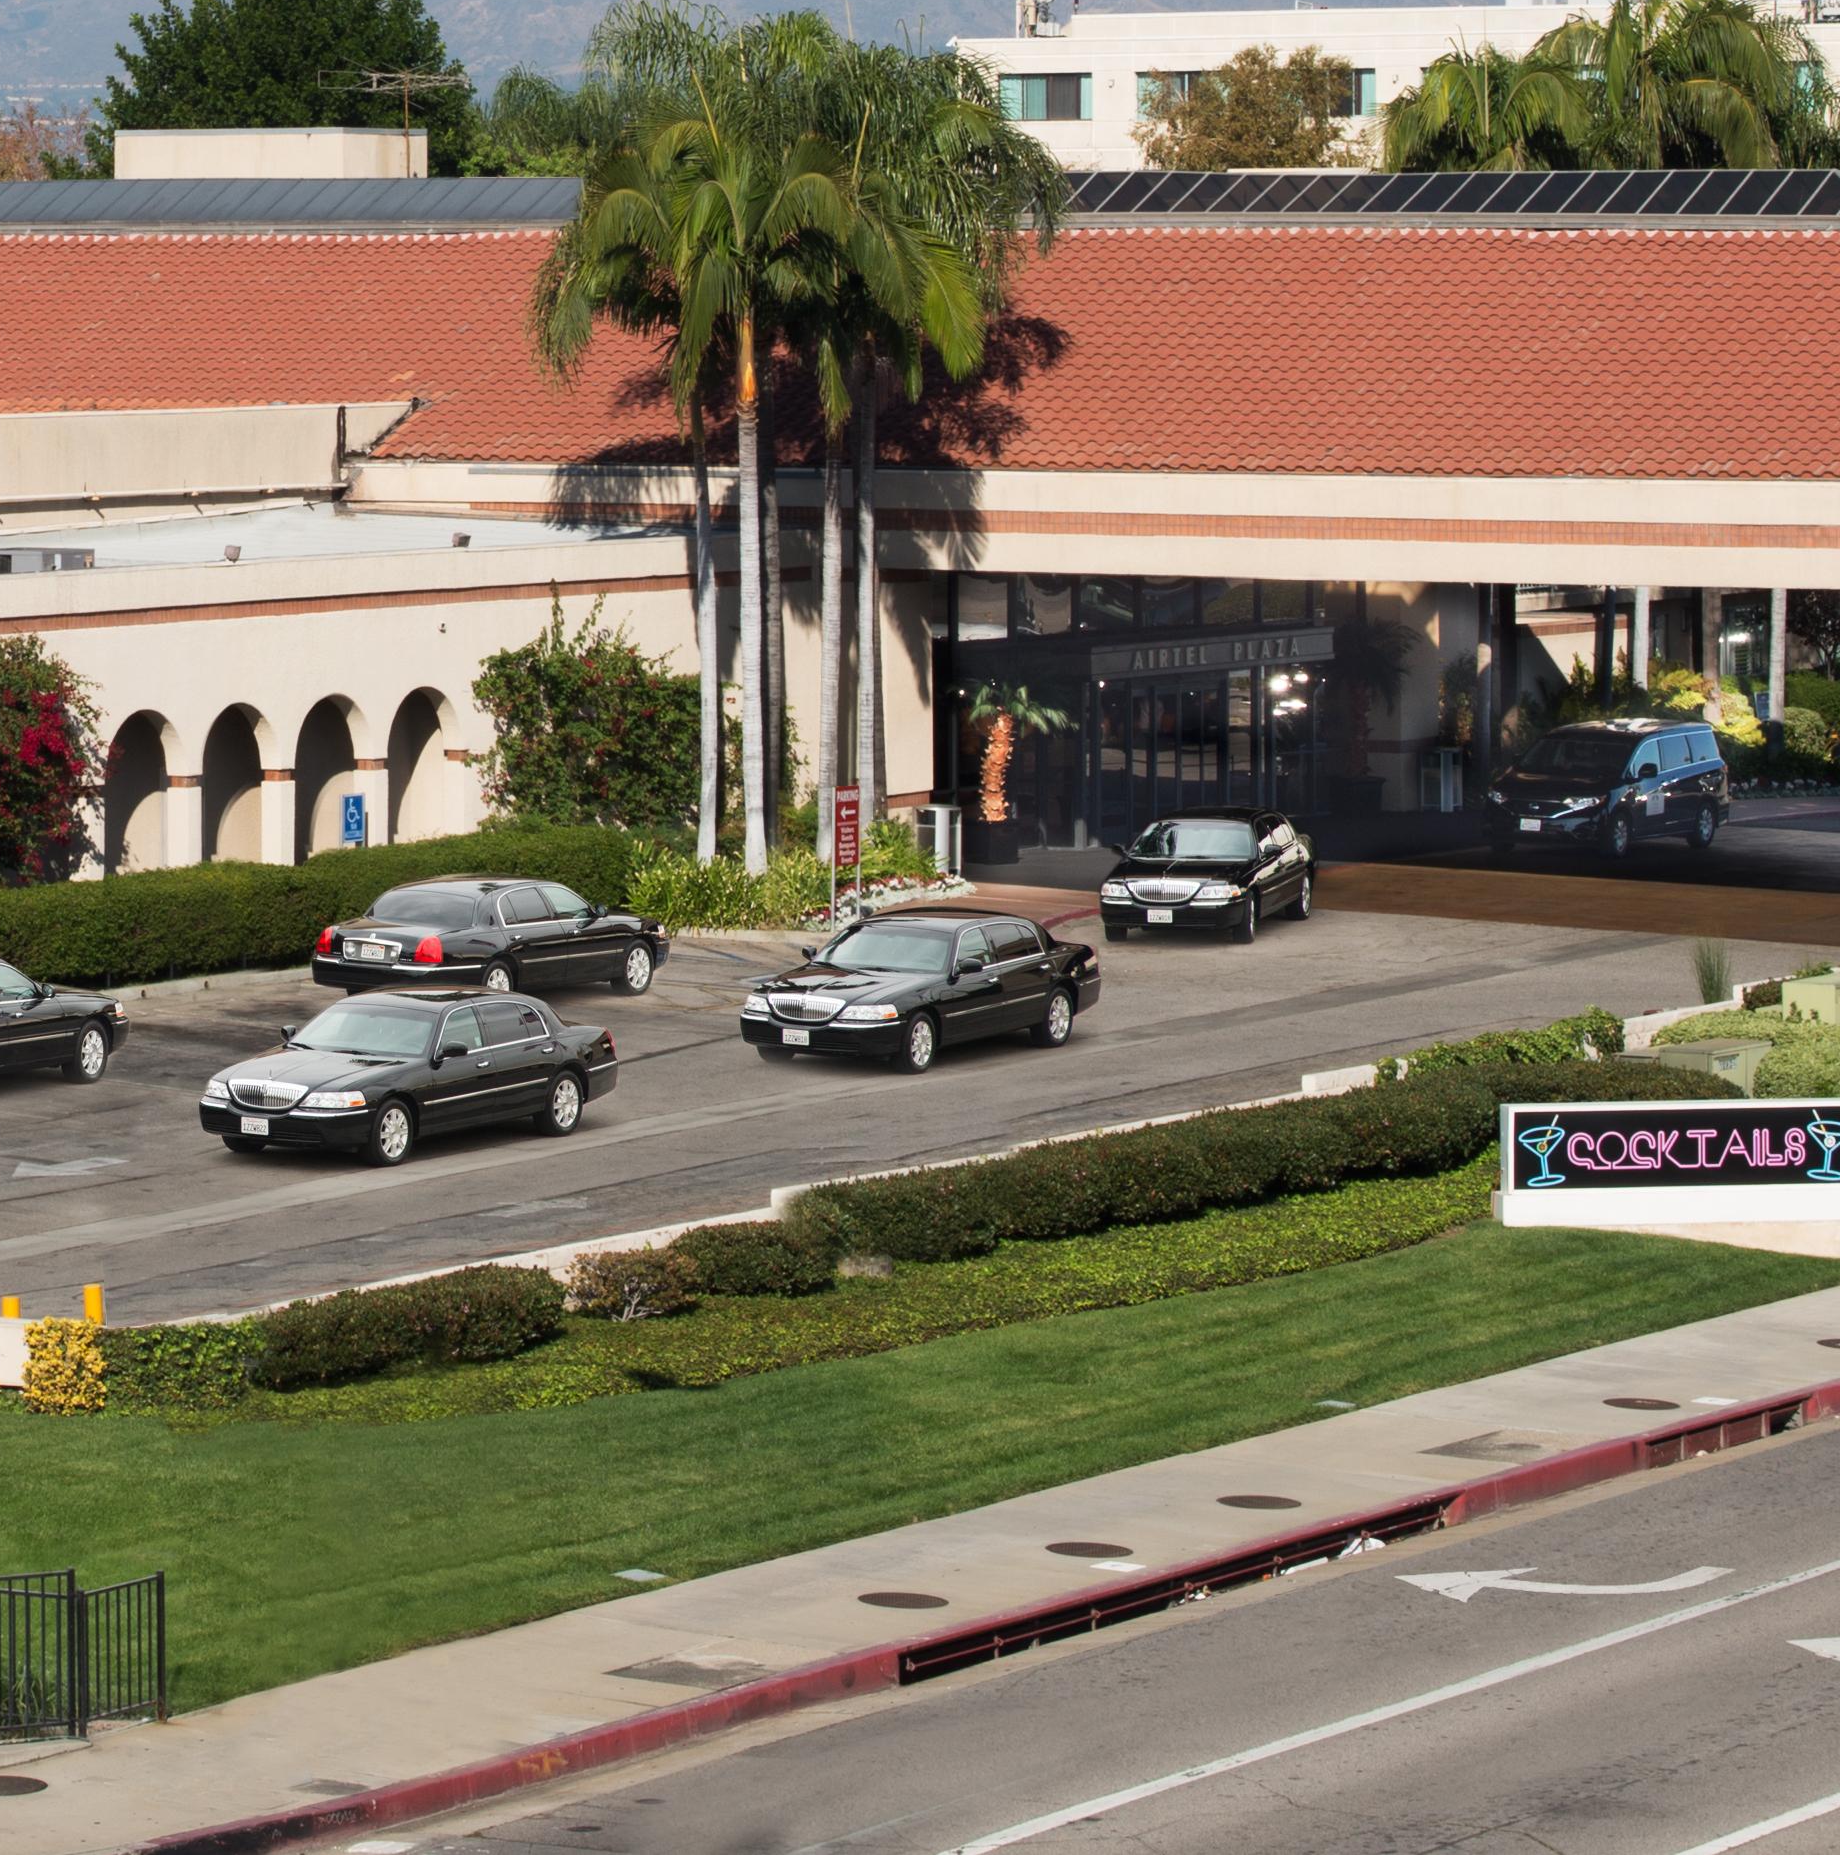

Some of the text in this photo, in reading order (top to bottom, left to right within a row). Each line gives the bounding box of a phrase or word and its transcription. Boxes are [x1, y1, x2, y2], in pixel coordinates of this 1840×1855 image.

[1132, 636, 1300, 671] AIRTEL PLAZA
[836, 788, 859, 803] PARKING
[1566, 1127, 1806, 1171] COCKTAILS
